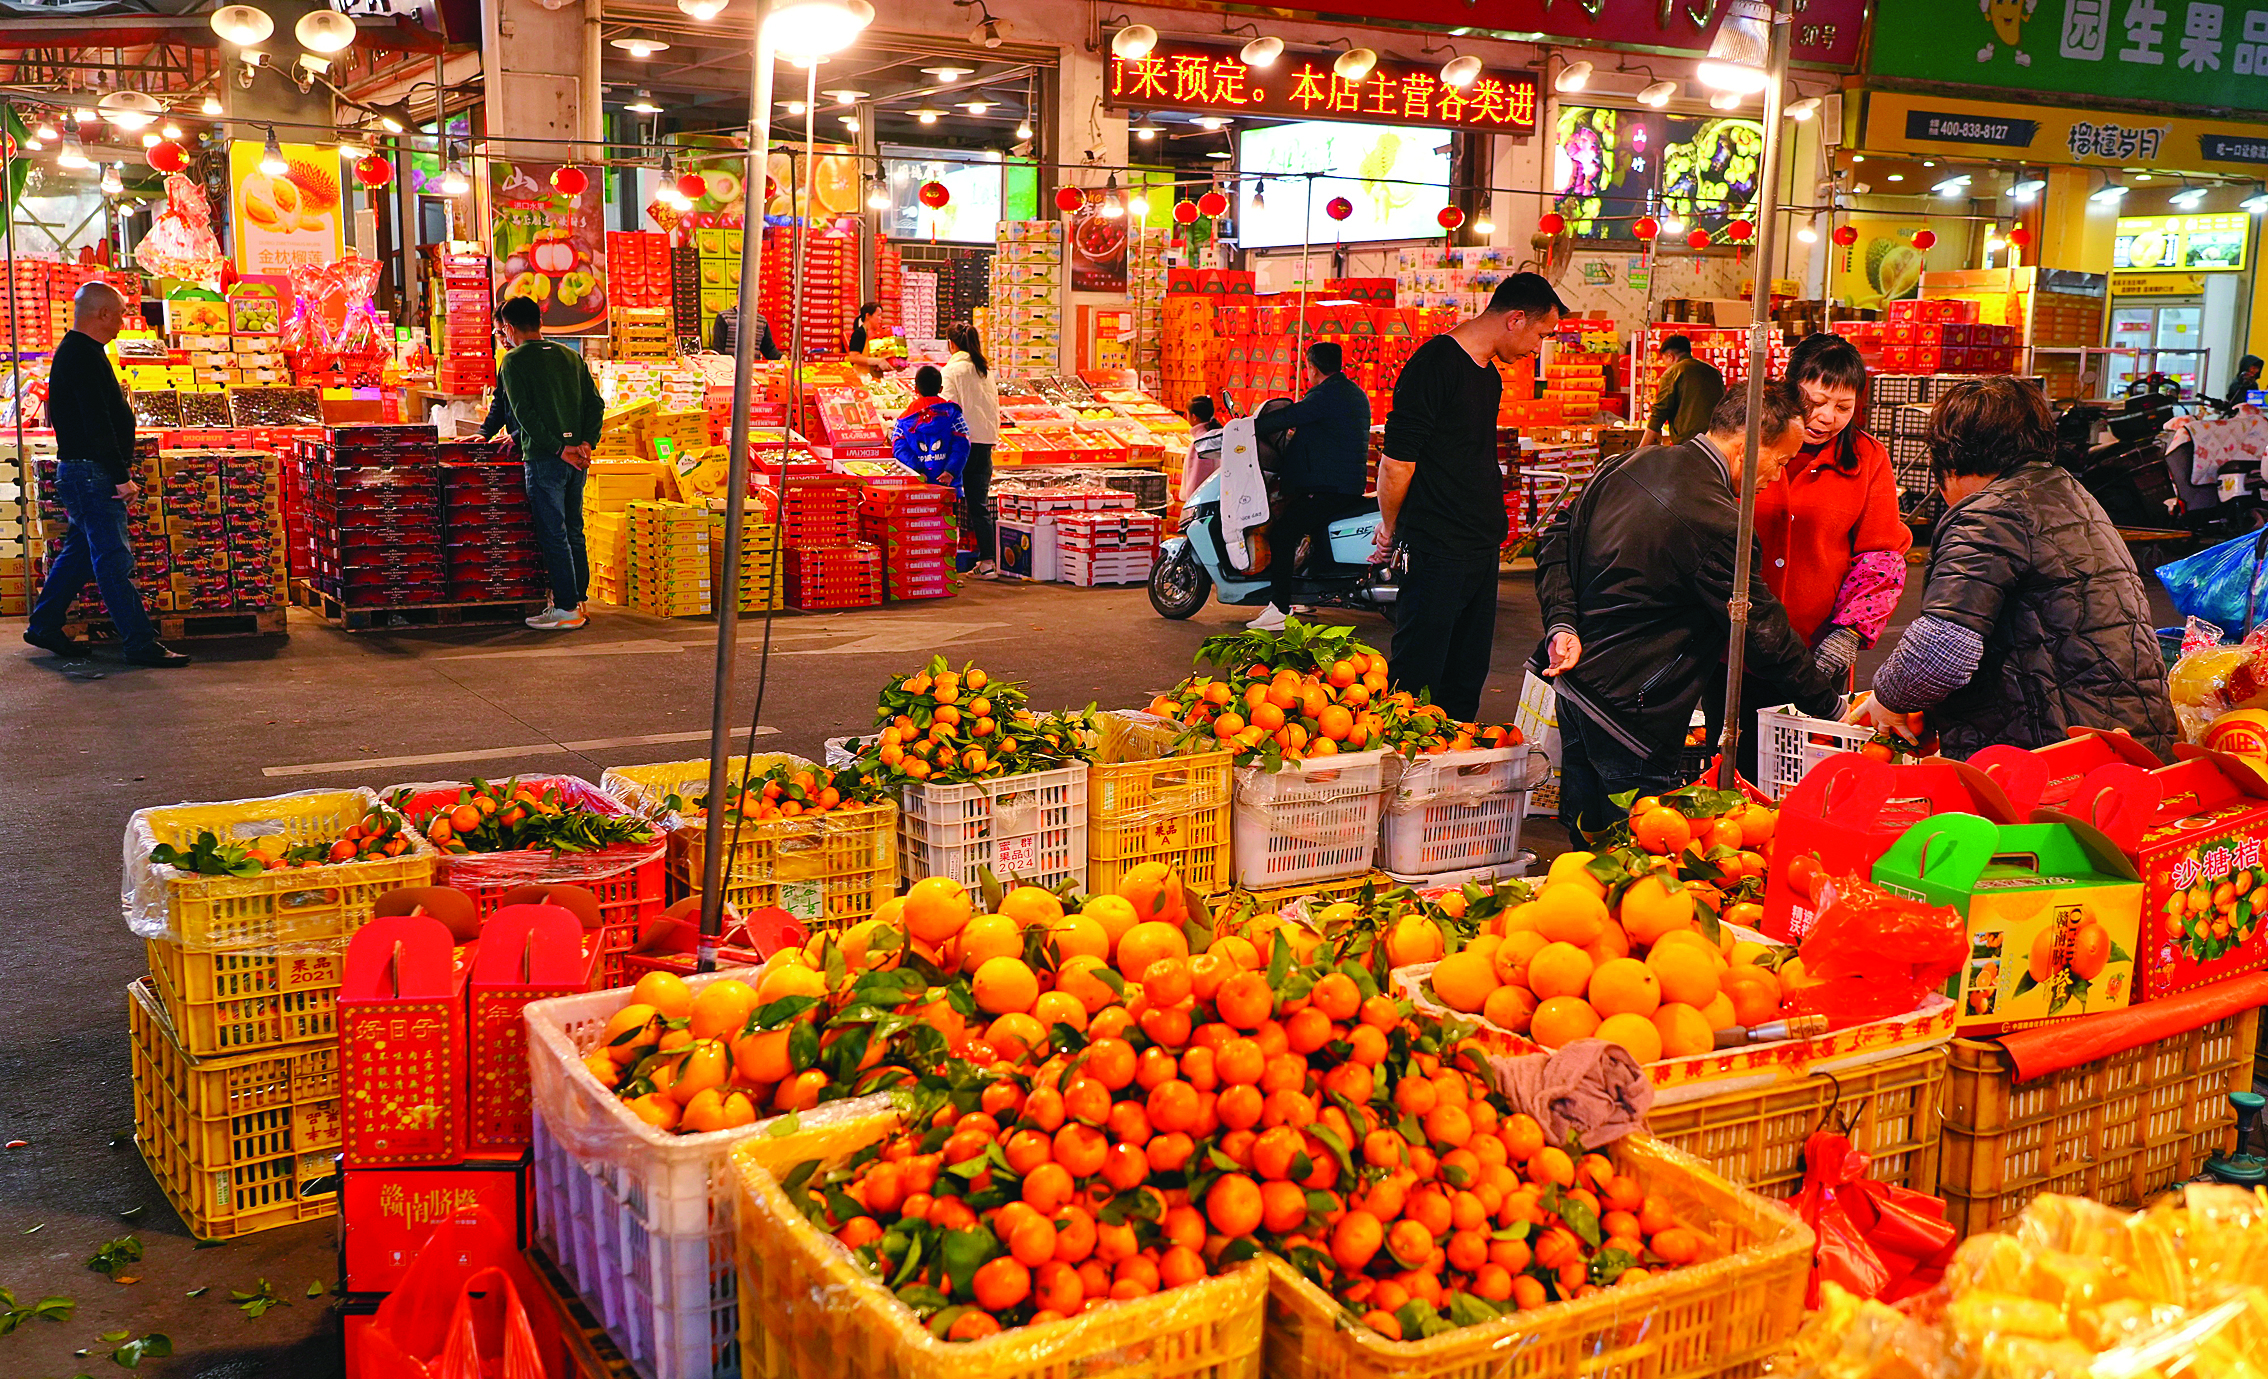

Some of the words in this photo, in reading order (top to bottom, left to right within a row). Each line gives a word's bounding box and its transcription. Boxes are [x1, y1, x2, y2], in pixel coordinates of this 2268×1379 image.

[1940, 121, 2009, 139] 400-838-8127
[514, 201, 545, 211] 进口水果
[258, 248, 324, 265] 金枕榴莲
[182, 434, 224, 443] DUOFRUT
[846, 449, 880, 458] REDKIWI
[910, 493, 942, 501] GREENKIWI
[910, 520, 941, 528] GREENKIWI
[911, 548, 942, 556] GREENKIWI
[910, 561, 941, 569] GREENKIWI
[912, 588, 943, 596] GREENKIWI
[1160, 835, 1171, 846] A
[999, 858, 1033, 873] 2024
[2171, 836, 2262, 891] 沙糖桔
[1791, 904, 1815, 926] 精选
[2043, 909, 2073, 1003] 赣南脐橙
[290, 956, 332, 974] 果品
[290, 969, 334, 985] 2021
[356, 1019, 441, 1042] 好日子
[305, 1109, 341, 1125] 果品
